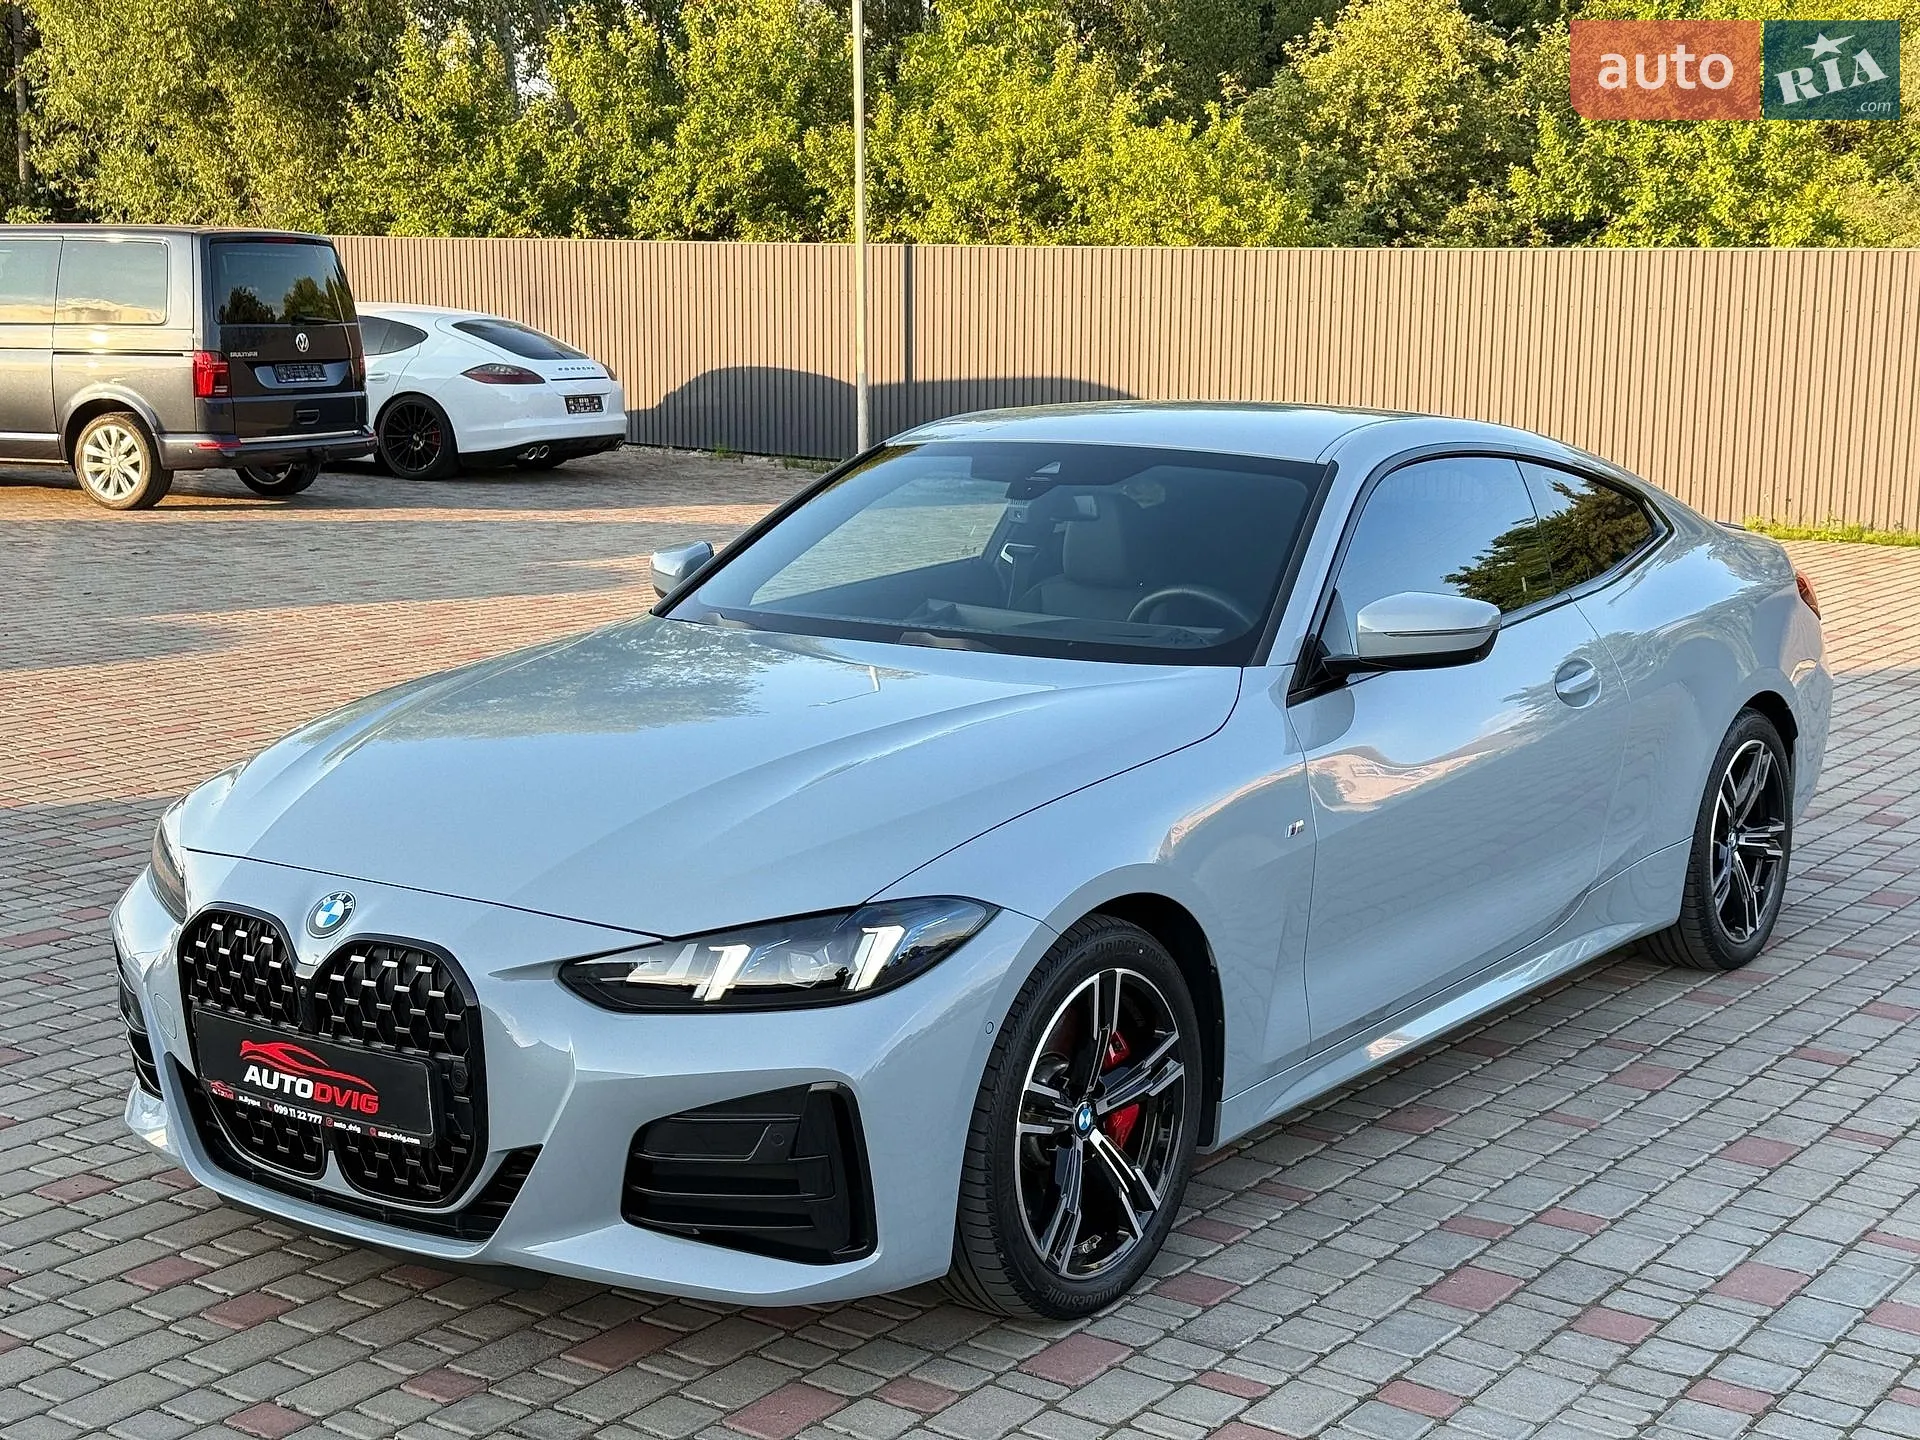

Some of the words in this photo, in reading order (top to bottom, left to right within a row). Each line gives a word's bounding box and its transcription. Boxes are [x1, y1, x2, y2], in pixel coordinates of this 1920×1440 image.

[322, 893, 353, 909] BMW
[243, 1065, 379, 1114] AUTODVIG
[273, 1104, 288, 1115] 099
[297, 1110, 307, 1121] 22
